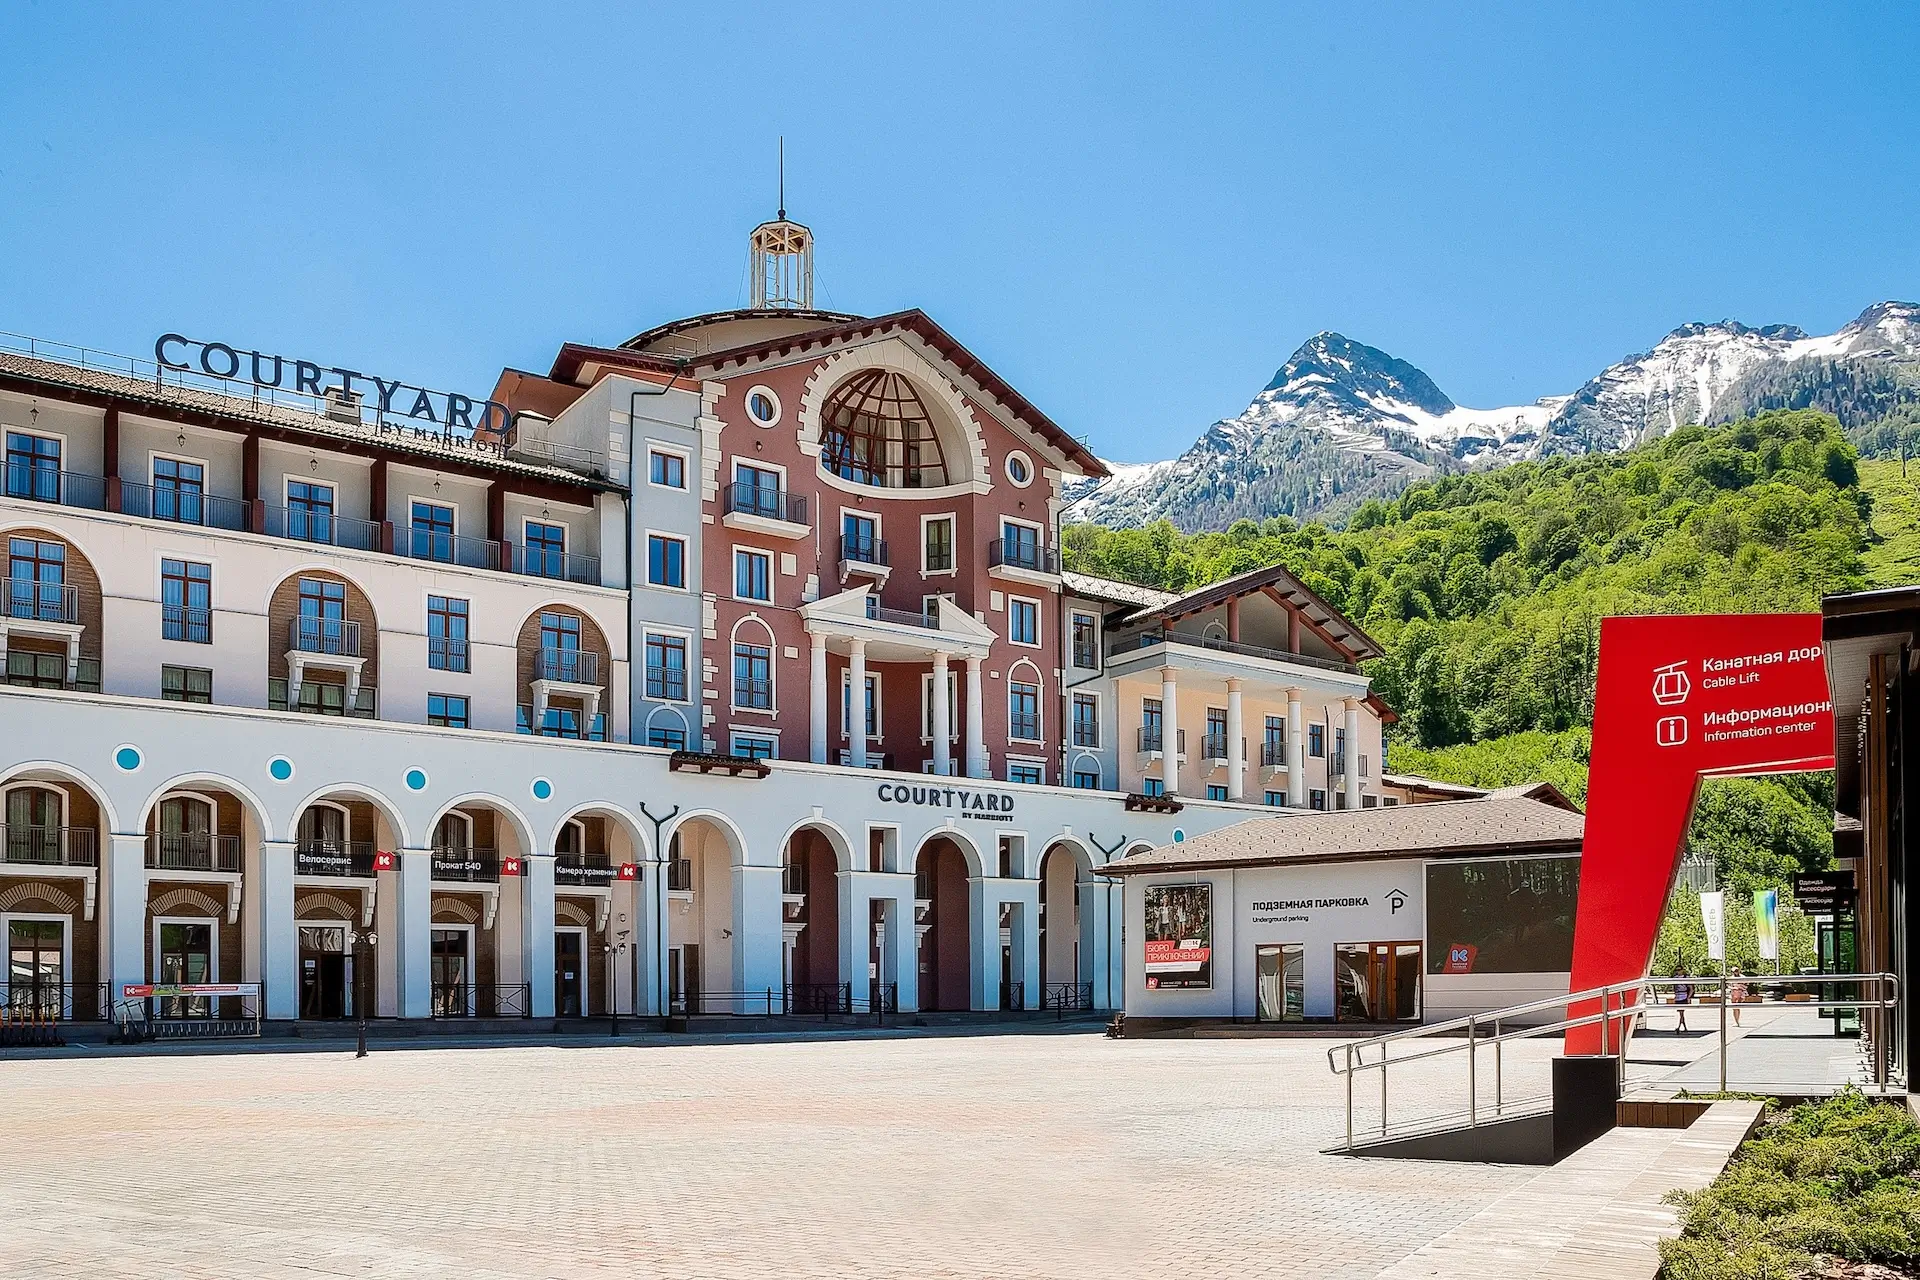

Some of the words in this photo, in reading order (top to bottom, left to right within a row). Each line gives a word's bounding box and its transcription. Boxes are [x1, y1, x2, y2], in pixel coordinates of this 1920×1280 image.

[154, 333, 513, 436] COURTYARD
[382, 421, 405, 435] BY
[414, 427, 512, 456] MARRIOTT
[1703, 651, 1783, 672] Канатная
[1787, 646, 1824, 663] дор
[1703, 676, 1736, 689] Cable
[1739, 672, 1760, 684] Lift
[1704, 724, 1772, 742] Information
[1775, 722, 1816, 734] center
[878, 784, 1014, 812] COURTYARD
[975, 814, 1014, 822] MARRIOTT
[299, 854, 352, 866] Велосервис
[435, 861, 463, 870] Прокат
[465, 862, 481, 870] 540
[556, 866, 583, 876] Камера
[584, 869, 617, 877] хранения
[1253, 900, 1313, 911] ПОДЗЕМНАЯ
[1315, 898, 1369, 908] ПАРКОВКА
[1288, 915, 1309, 923] parking
[1147, 944, 1170, 952] БЮРО
[1147, 950, 1205, 961] ПРИКЛЮЧЕНИЙ
